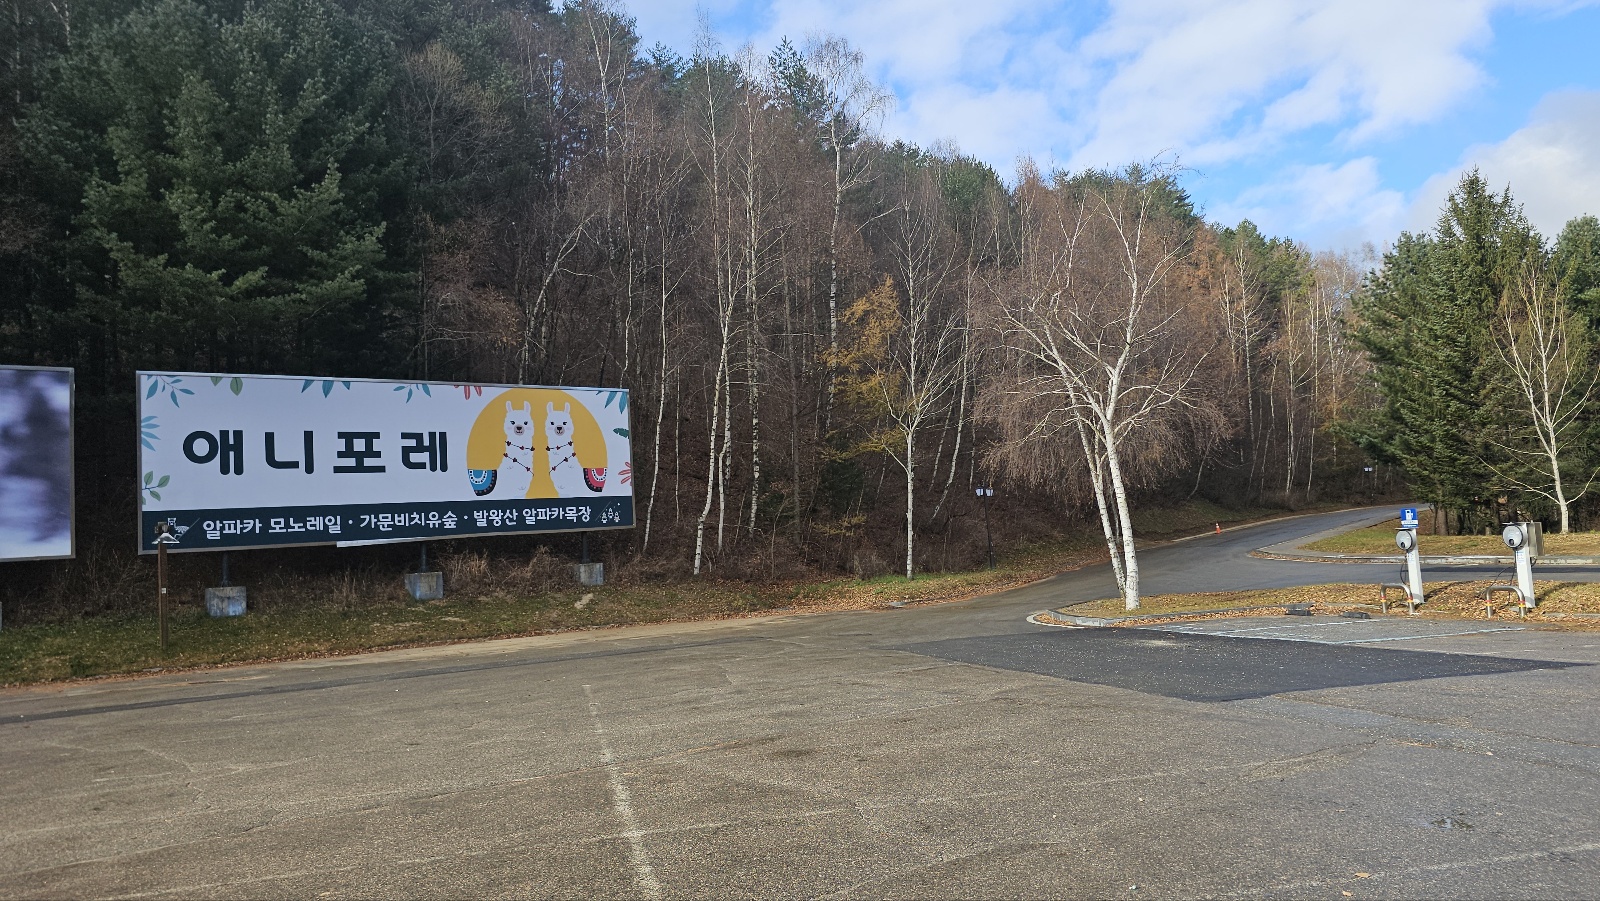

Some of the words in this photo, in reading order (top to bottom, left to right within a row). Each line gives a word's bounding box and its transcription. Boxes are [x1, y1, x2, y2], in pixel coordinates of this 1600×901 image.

[182, 429, 449, 476] 애니포레
[202, 518, 263, 540] 알파카
[268, 515, 342, 534] 모노레일
[359, 510, 458, 532] 가문비치유숲
[473, 508, 519, 527] 발왕산
[522, 505, 592, 525] 알파카목장
